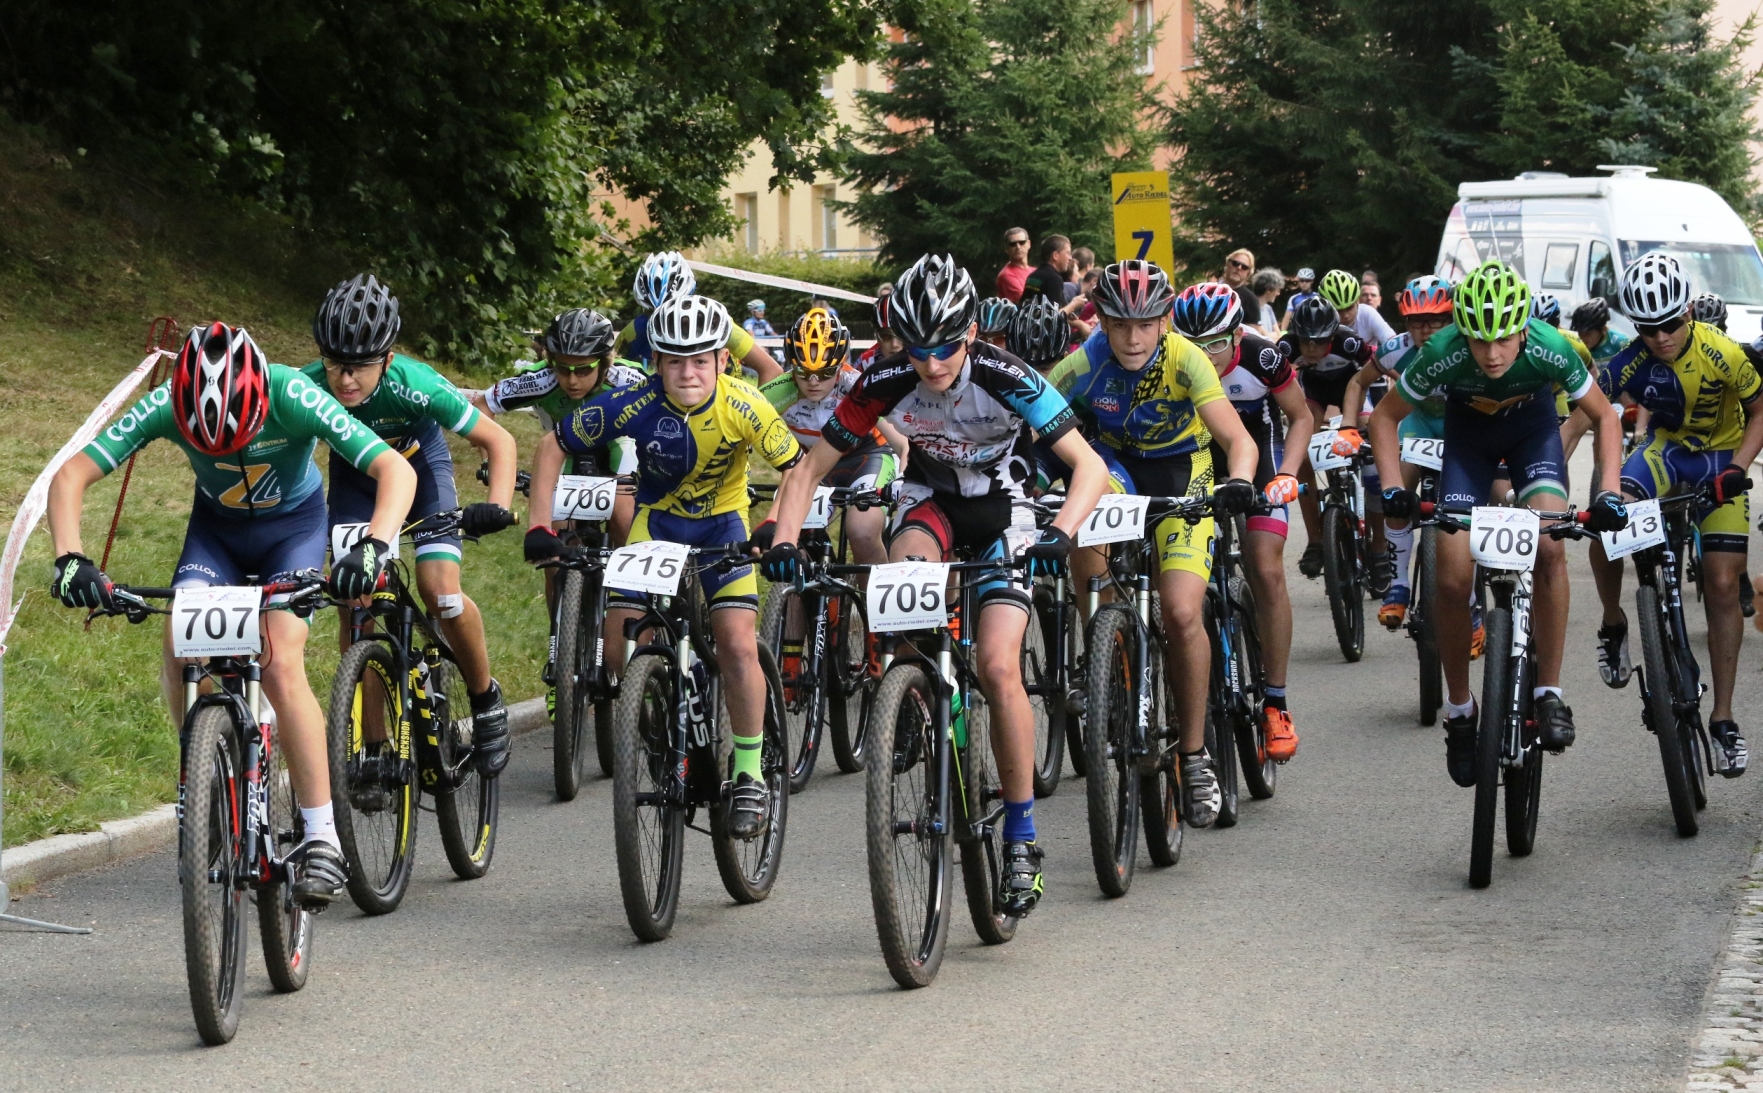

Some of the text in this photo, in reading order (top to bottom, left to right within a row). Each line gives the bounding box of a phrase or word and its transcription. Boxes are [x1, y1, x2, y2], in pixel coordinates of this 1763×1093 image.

[1132, 230, 1154, 262] 7
[1426, 347, 1469, 377] COLLOS
[1524, 341, 1569, 369] COLLOS
[389, 380, 431, 407] OLLOS
[613, 389, 658, 430] CORTEK
[725, 394, 764, 434] CORTEK
[1311, 442, 1336, 462] 72
[563, 488, 610, 511] 706
[1445, 493, 1475, 503] COLLOS
[1090, 506, 1140, 532] 701
[1478, 526, 1534, 556] 708
[178, 563, 216, 578] COLLOS
[617, 552, 679, 579] 715
[875, 582, 941, 614] 705
[181, 607, 254, 641] 707
[400, 721, 411, 760] ROCKSHOX
